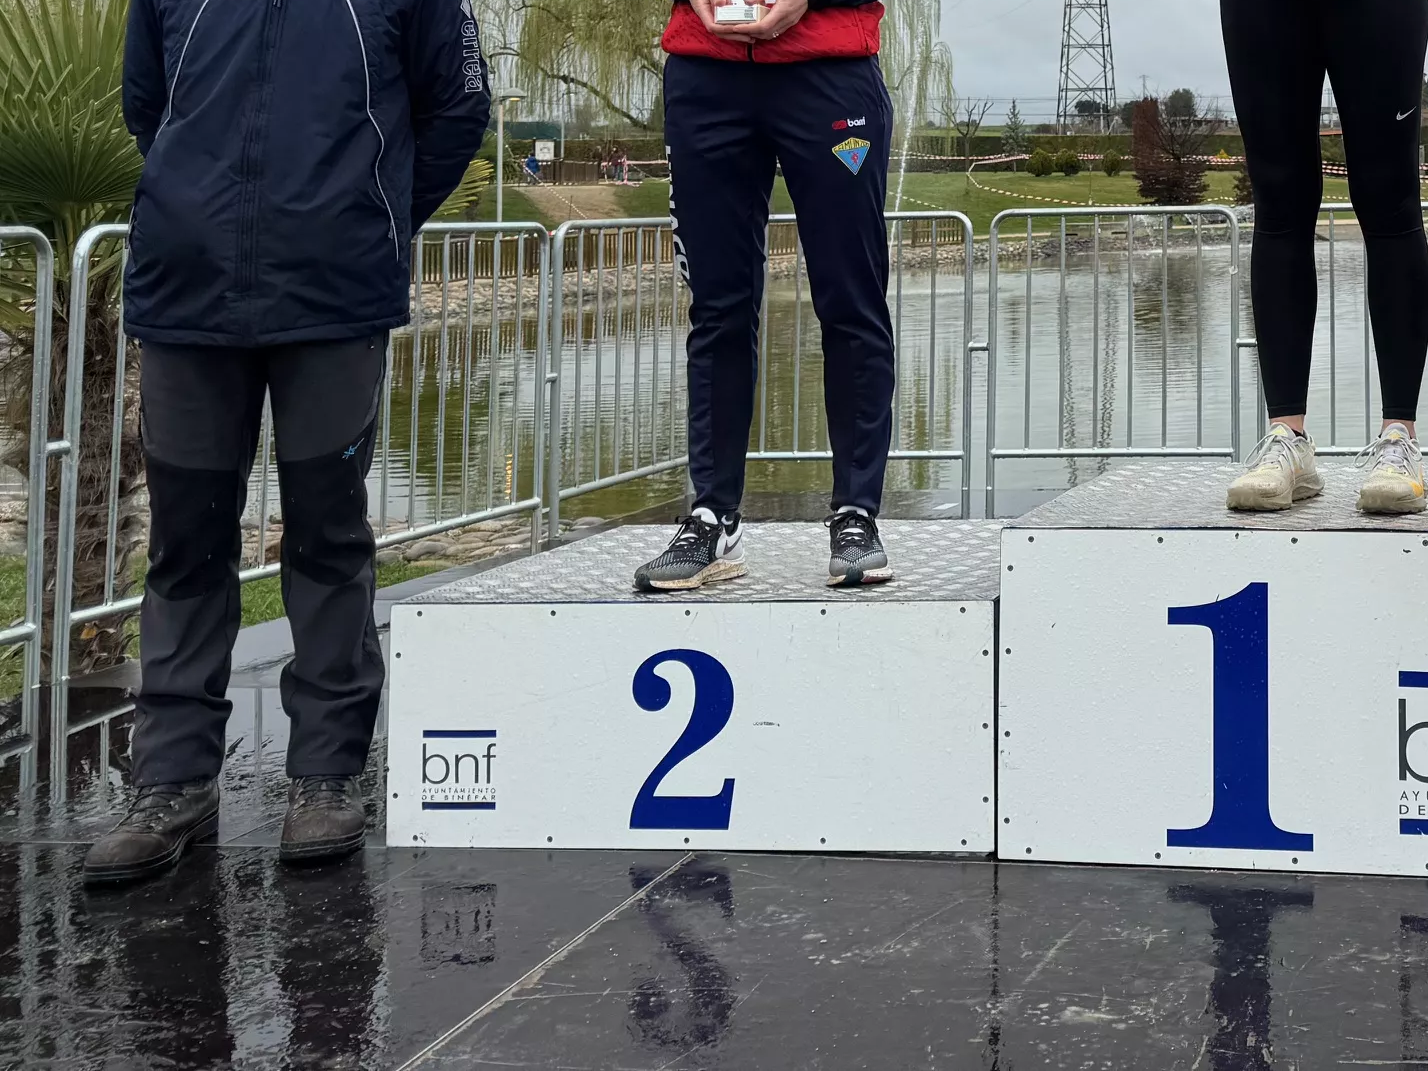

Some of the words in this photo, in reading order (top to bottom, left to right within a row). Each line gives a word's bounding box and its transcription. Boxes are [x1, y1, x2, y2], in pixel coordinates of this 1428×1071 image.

[461, 20, 483, 93] errea
[630, 649, 735, 830] 2
[1167, 582, 1313, 851] 1
[422, 743, 497, 785] bnf
[1399, 804, 1426, 816] DE
